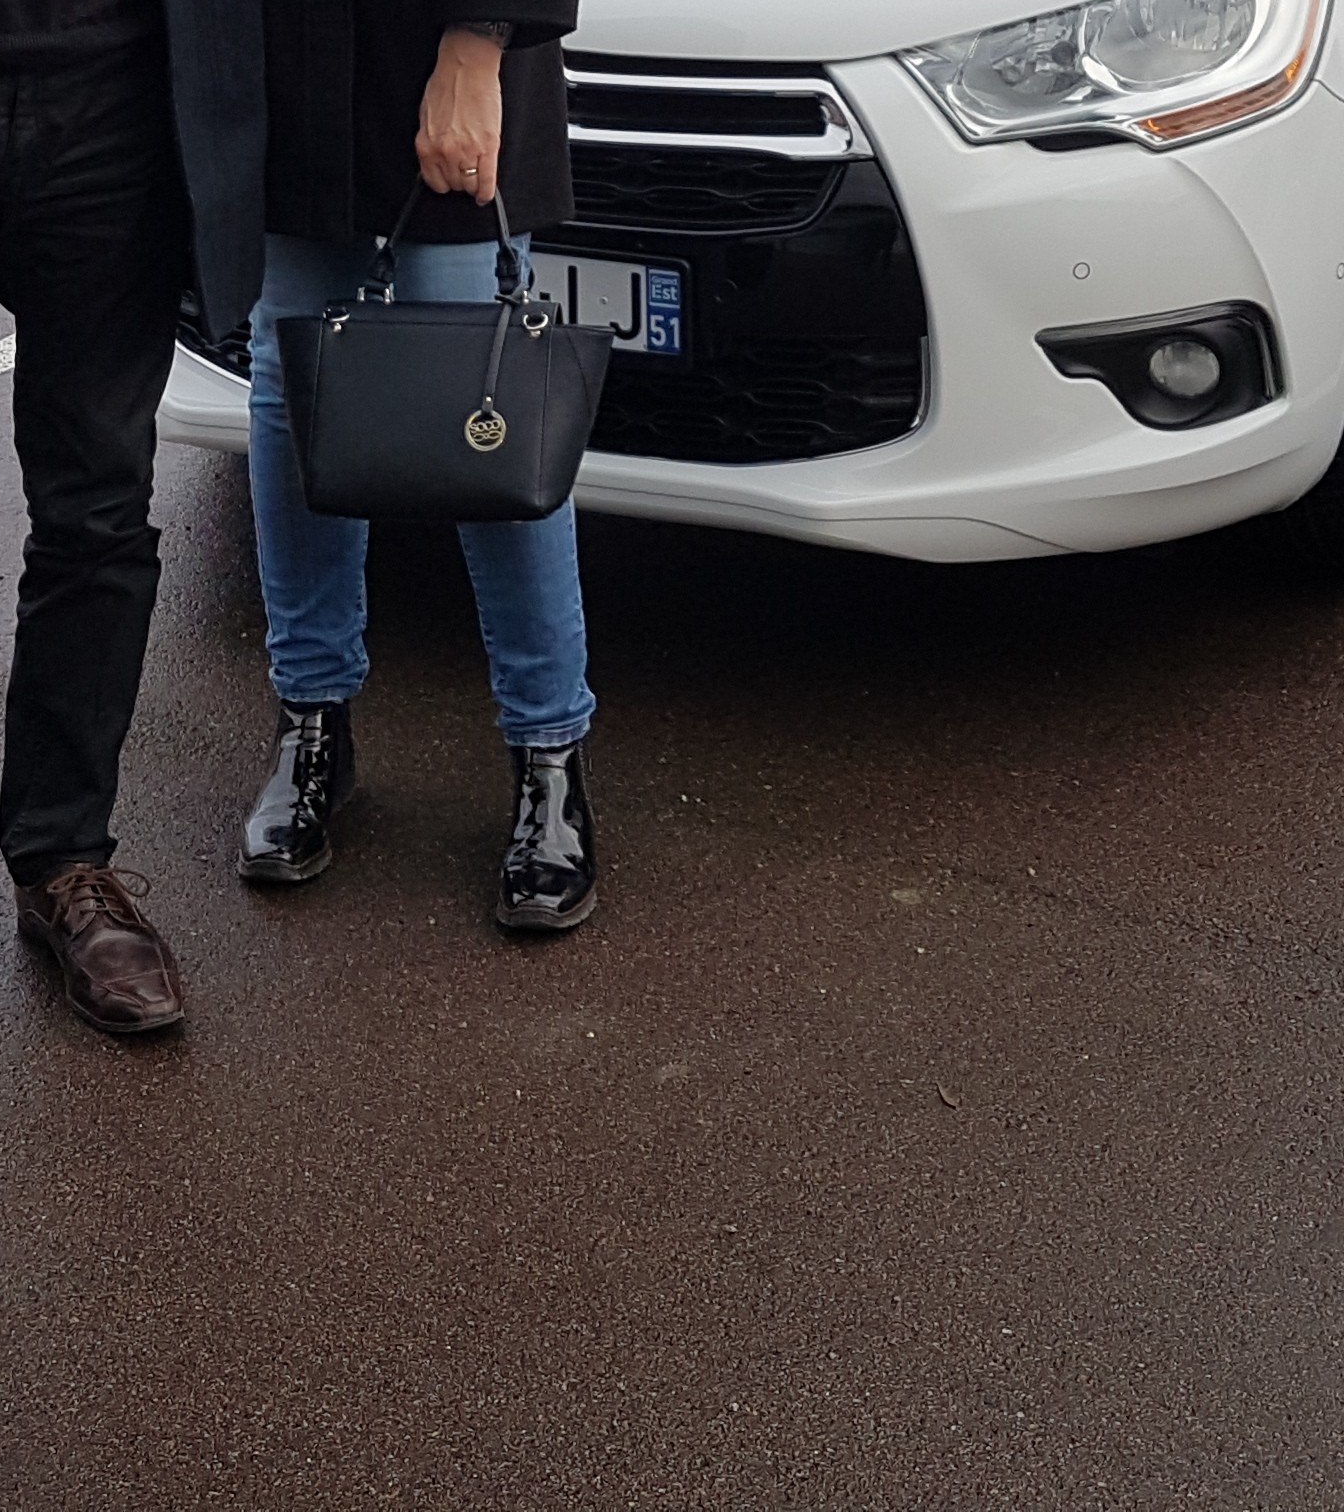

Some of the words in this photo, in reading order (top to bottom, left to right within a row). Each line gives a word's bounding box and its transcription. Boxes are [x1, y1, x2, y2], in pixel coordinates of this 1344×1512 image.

[651, 275, 678, 286] Grand
[651, 284, 678, 301] Est
[650, 314, 680, 349] 51
